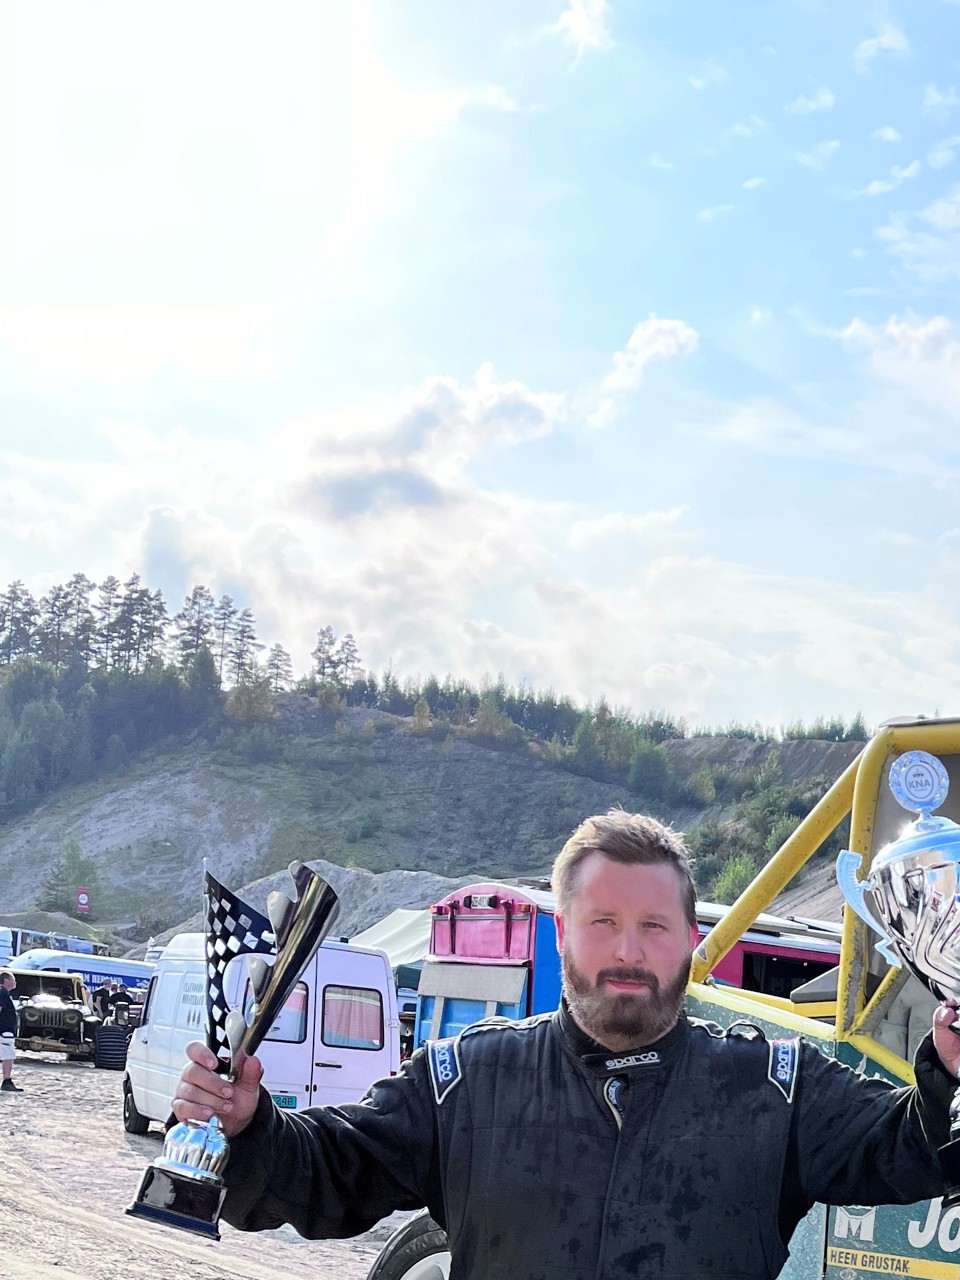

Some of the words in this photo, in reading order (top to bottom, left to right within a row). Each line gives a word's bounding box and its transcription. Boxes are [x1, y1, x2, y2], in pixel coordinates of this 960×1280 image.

[908, 778, 931, 789] KNA
[434, 1041, 453, 1082] parco
[606, 1051, 660, 1070] sparco
[776, 1041, 792, 1082] sparc
[830, 1250, 858, 1266] HEEN
[861, 1254, 910, 1273] GRUSTAK
